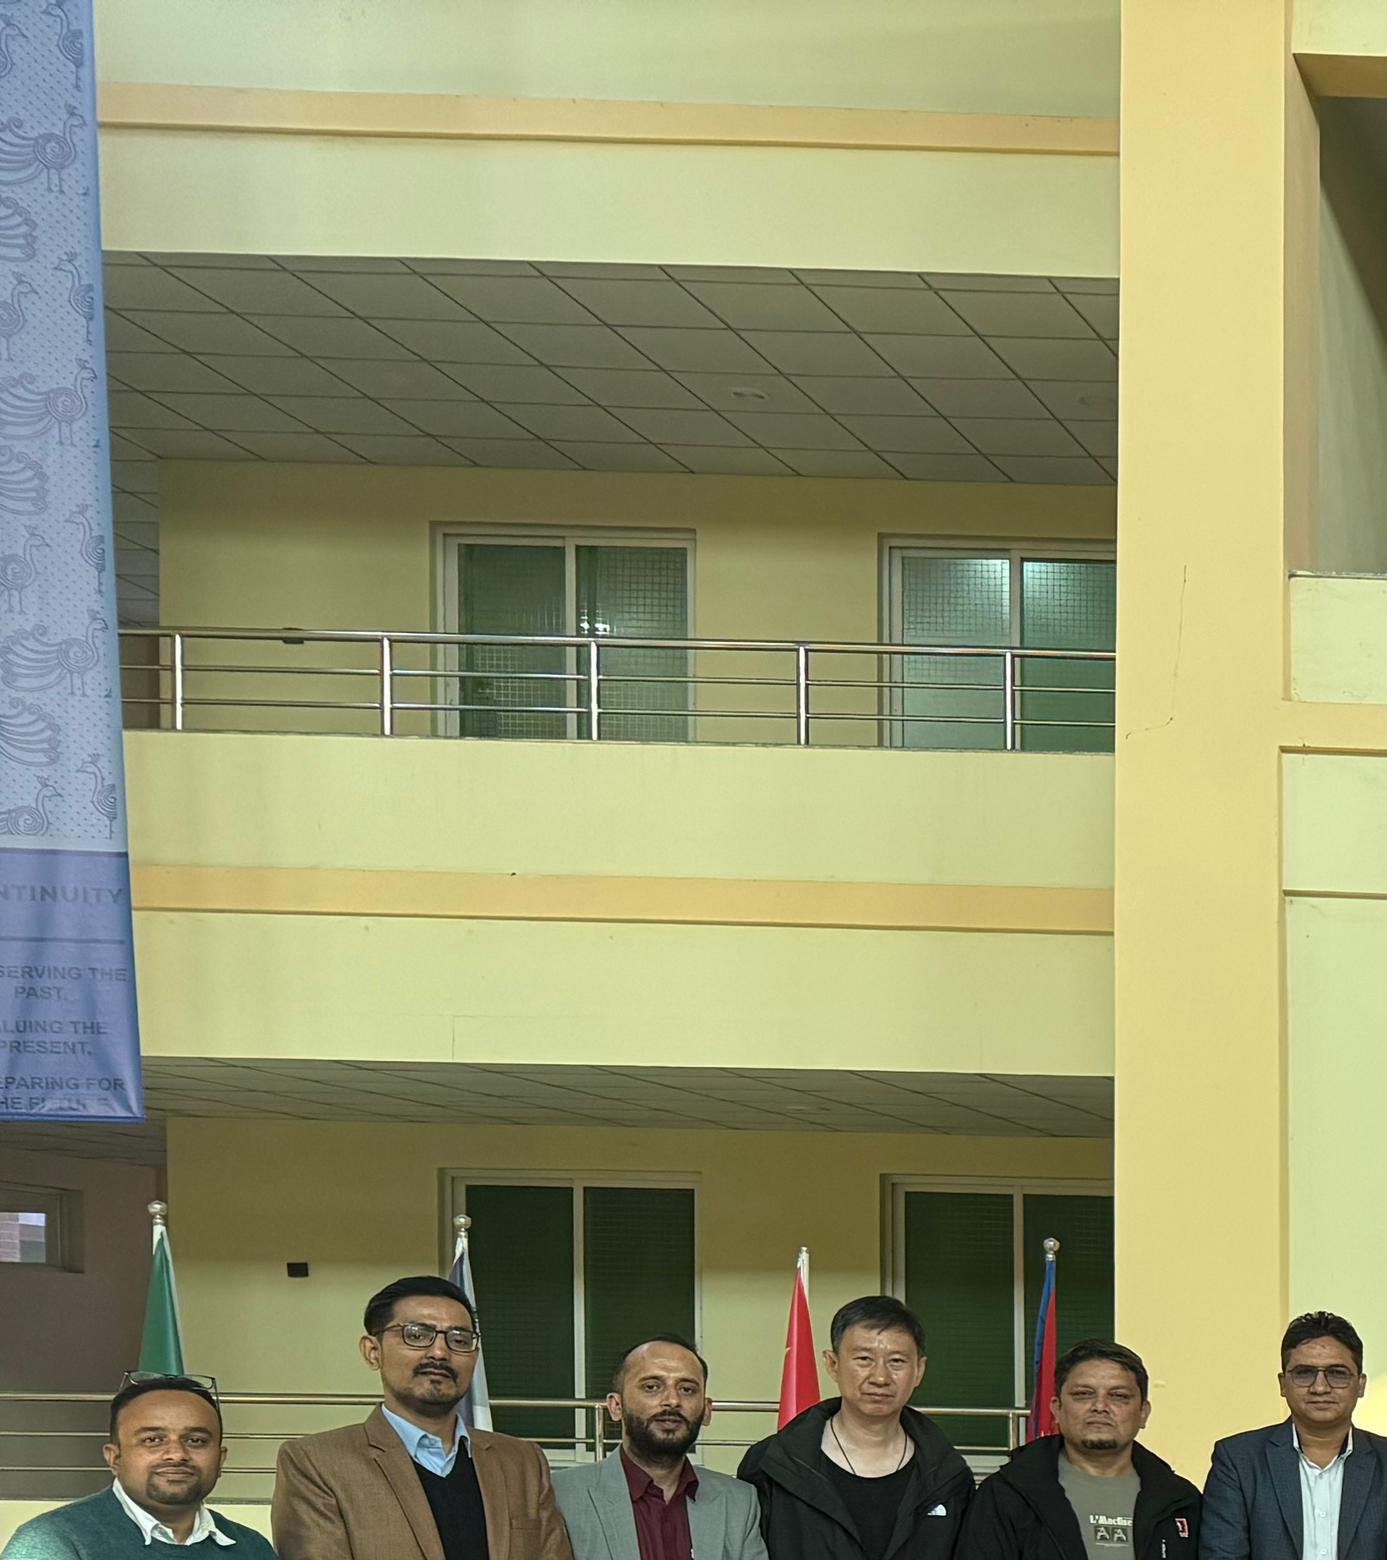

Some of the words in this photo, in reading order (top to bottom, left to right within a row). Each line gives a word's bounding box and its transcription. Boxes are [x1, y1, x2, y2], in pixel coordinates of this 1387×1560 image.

[89, 967, 127, 982] THE
[0, 1020, 63, 1034] LUING
[70, 1020, 108, 1035] THE
[86, 1078, 127, 1093] FOR
